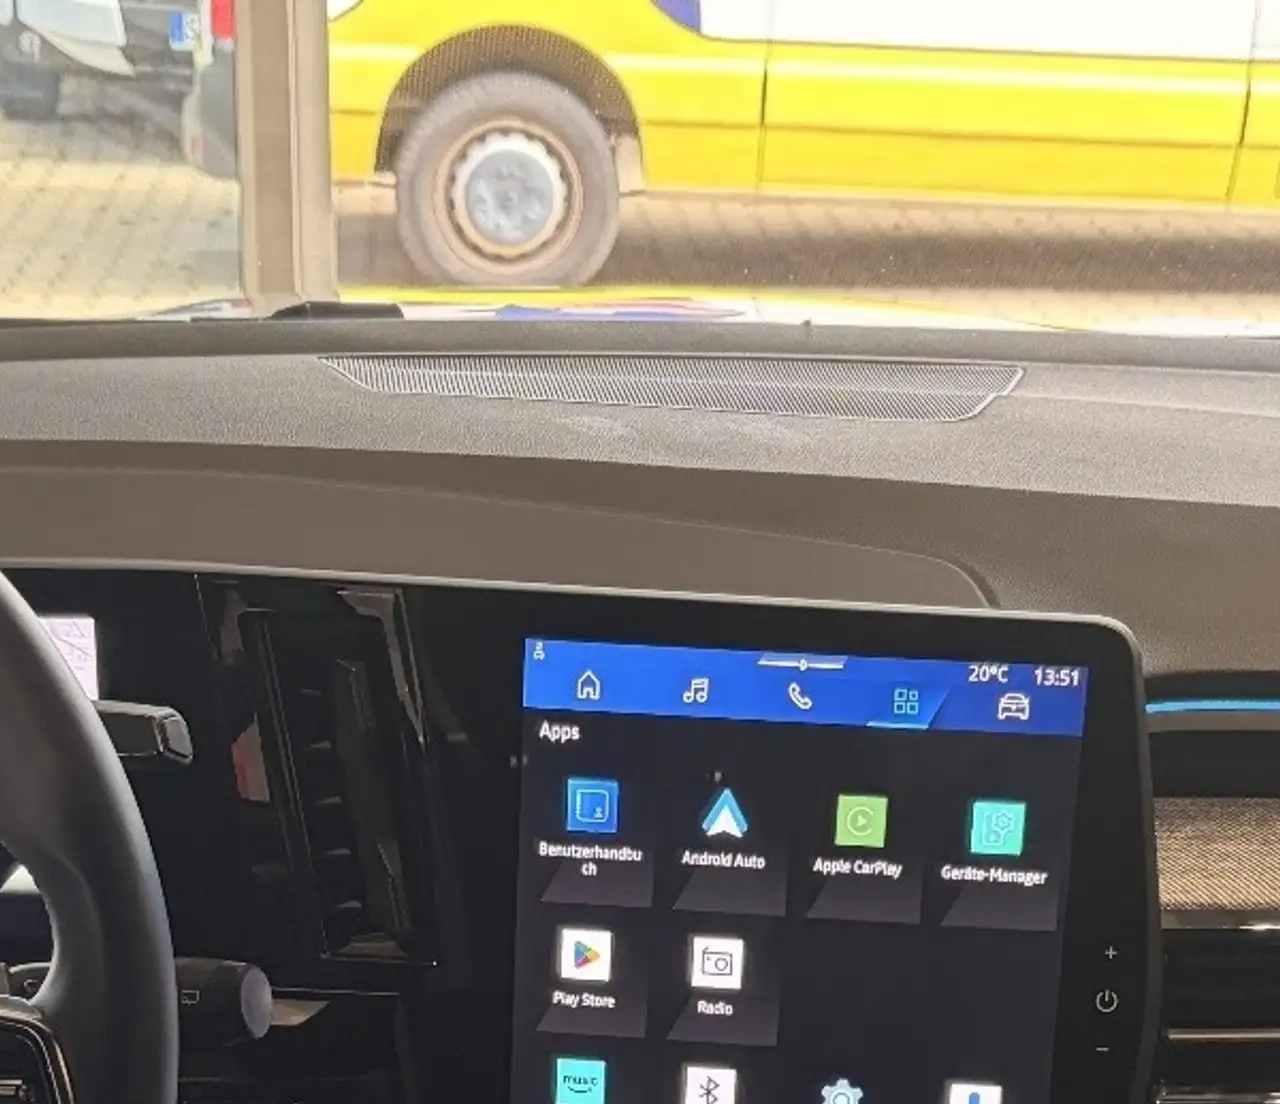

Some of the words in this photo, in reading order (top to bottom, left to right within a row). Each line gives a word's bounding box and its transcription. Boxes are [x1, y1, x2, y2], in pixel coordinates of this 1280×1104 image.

[967, 664, 1009, 683] 20°C
[1034, 667, 1079, 687] 13:51
[539, 719, 580, 744] Apps
[538, 841, 643, 862] Benutzerhandbu
[681, 850, 732, 868] Android
[734, 852, 766, 869] Auto
[581, 863, 598, 876] ch
[813, 857, 851, 876] Apple
[853, 859, 903, 880] CarPlay
[940, 864, 1049, 887] Geräte-Manager
[552, 990, 579, 1009] Play
[581, 992, 617, 1009] Store
[697, 1000, 734, 1016] Radio
